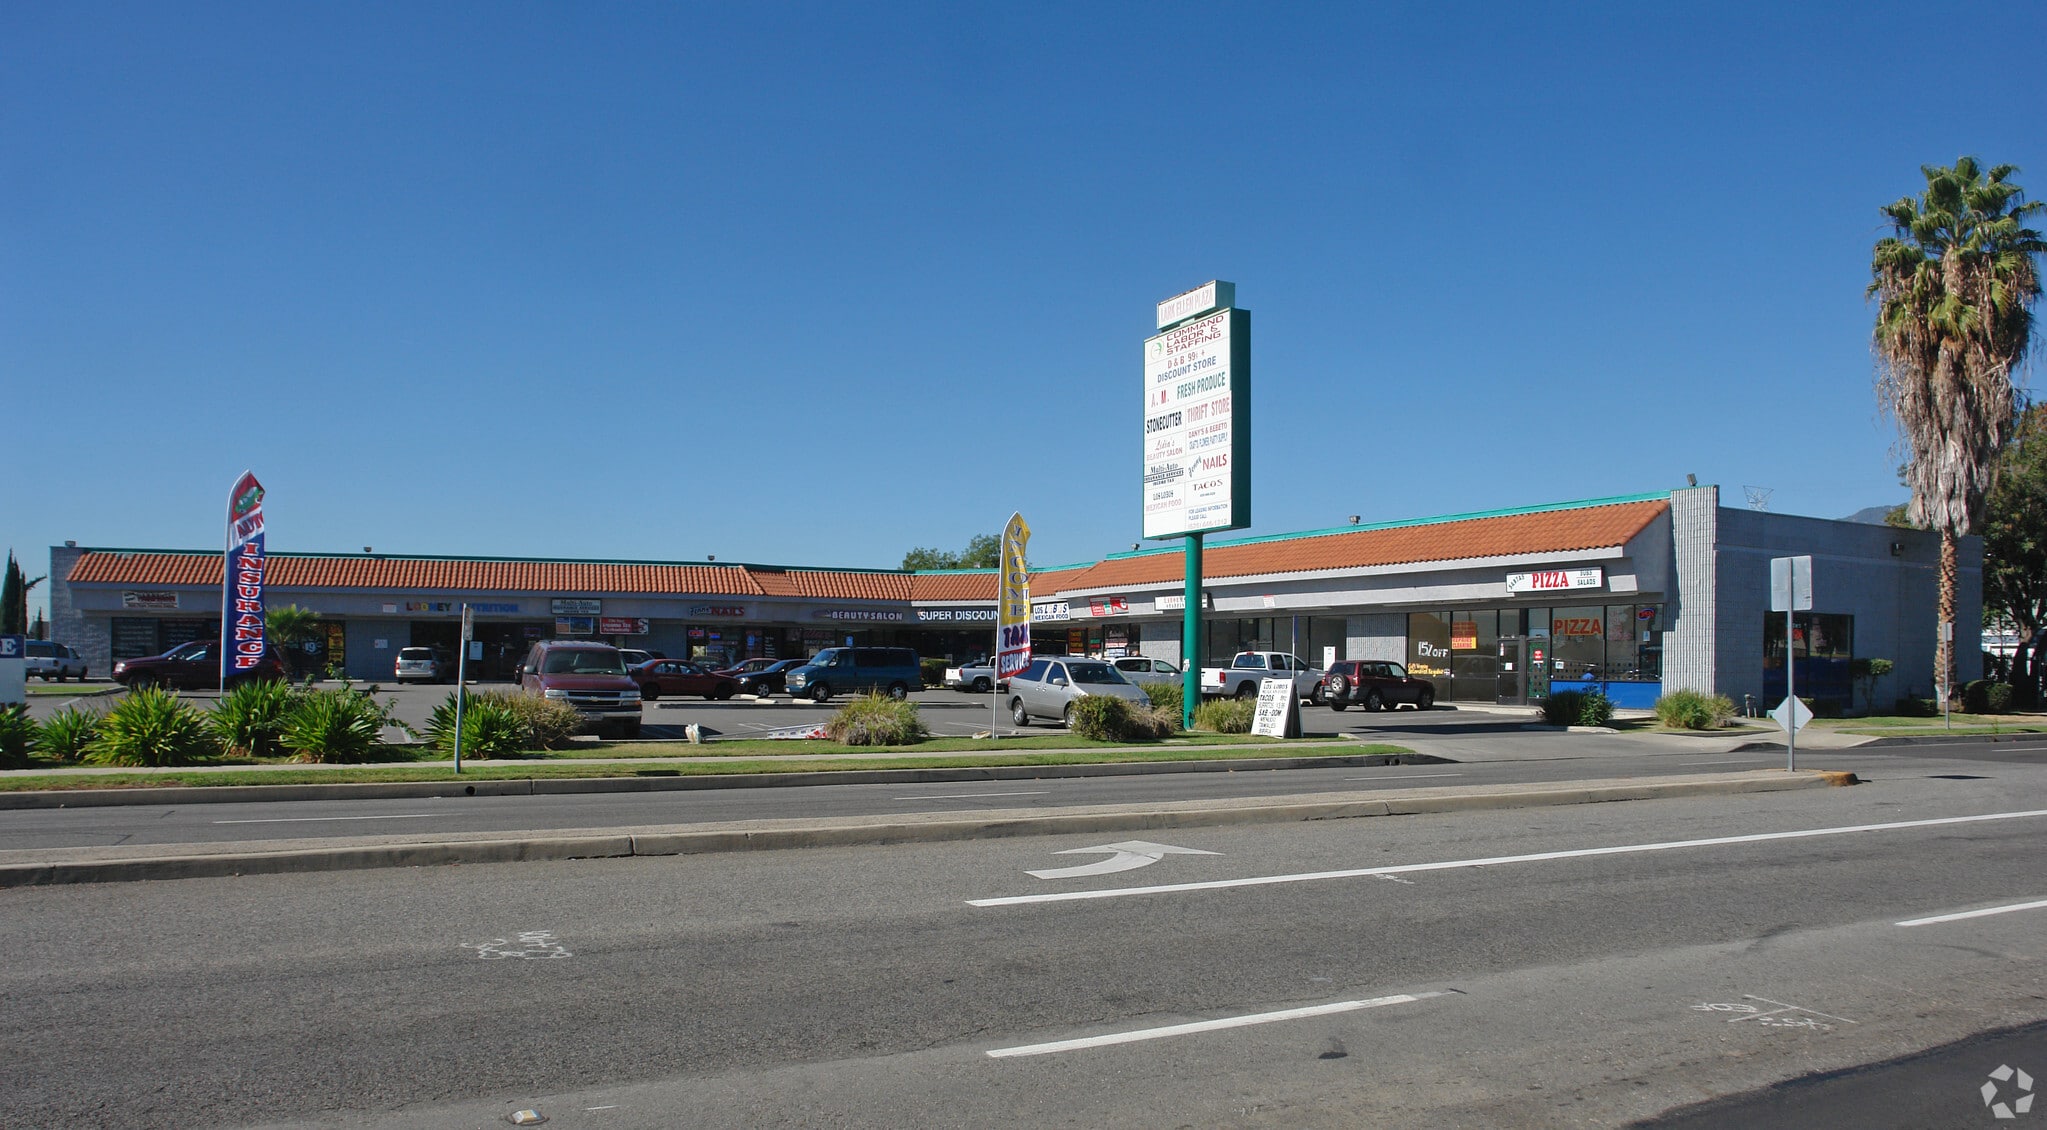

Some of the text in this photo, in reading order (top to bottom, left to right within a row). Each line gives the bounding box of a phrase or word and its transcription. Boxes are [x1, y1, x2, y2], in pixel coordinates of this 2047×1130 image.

[1166, 315, 1224, 341] COMMAND
[1166, 329, 1204, 348] LABOR
[1166, 331, 1221, 355] STAFFING
[1157, 355, 1217, 383] DISCOUNT STORE
[1176, 382, 1196, 400] FRESH
[1196, 371, 1226, 394] PRODUCE
[1187, 396, 1230, 424] THRIFT STORE
[1146, 411, 1182, 434] STONECUTTER
[1166, 446, 1183, 457] SALON
[1202, 453, 1228, 472] NAILS
[1193, 478, 1223, 491] TACOS
[1005, 524, 1030, 617] INCOME
[1531, 570, 1569, 588] PIZZA
[1577, 578, 1596, 586] SALADS
[235, 542, 264, 669] INSURANCE
[711, 606, 745, 617] NAILS
[1034, 606, 1044, 615] LOS
[832, 611, 869, 620] BEAUTY
[870, 612, 903, 621] SALON
[919, 610, 999, 621] SUPER DISCOUN
[1003, 623, 1029, 648] TAX
[1553, 619, 1602, 635] PIZZA
[1000, 650, 1030, 674] SERVICE
[1432, 648, 1449, 658] OFF
[1259, 694, 1275, 702] TACOS
